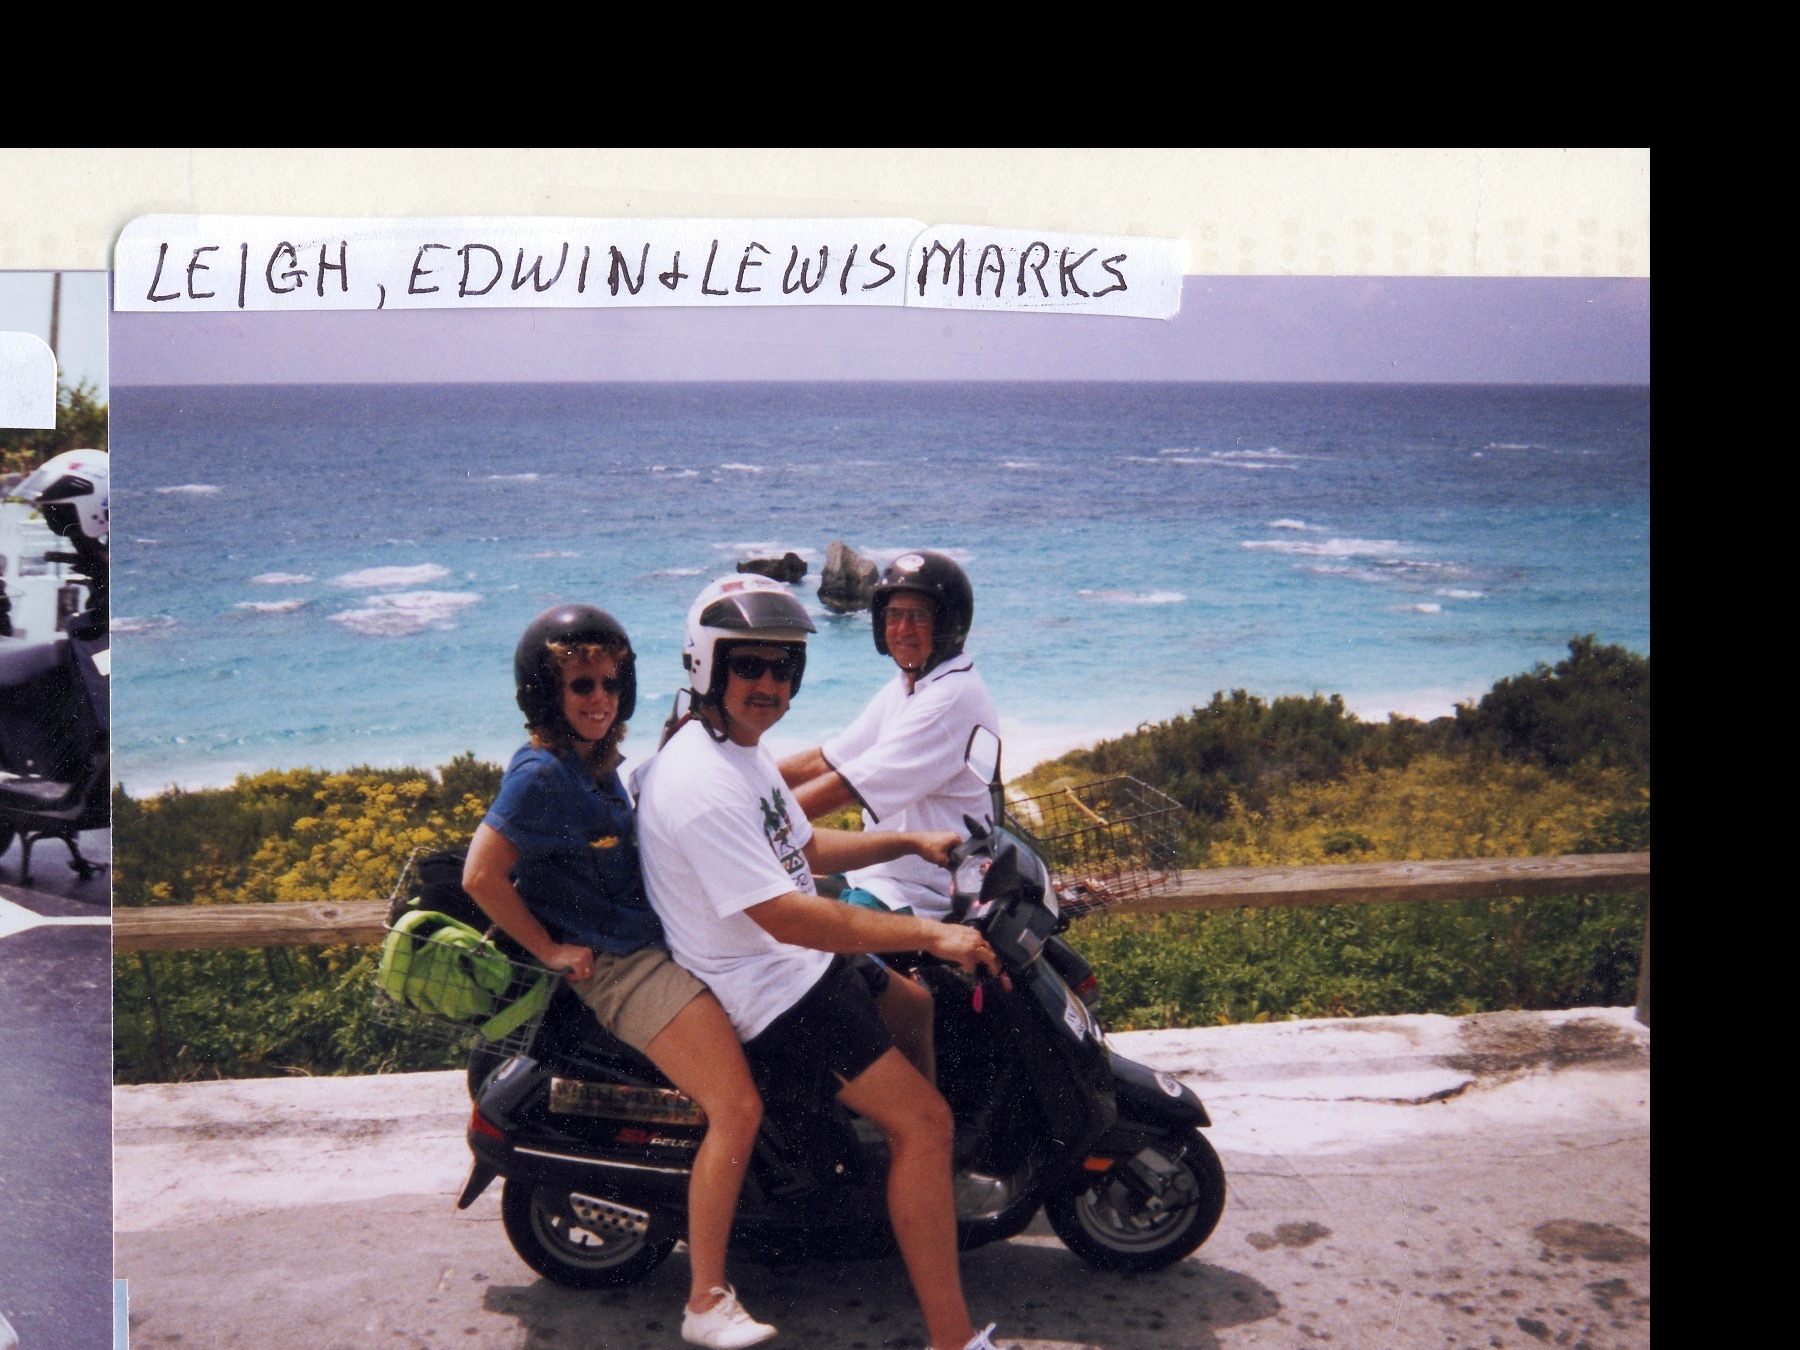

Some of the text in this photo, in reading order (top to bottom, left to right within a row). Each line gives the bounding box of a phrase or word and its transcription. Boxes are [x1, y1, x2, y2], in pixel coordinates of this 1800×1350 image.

[146, 241, 386, 309] LEIGH,
[407, 242, 650, 298] EDWIN
[701, 243, 896, 296] LEWIS
[917, 238, 1128, 298] MARKS
